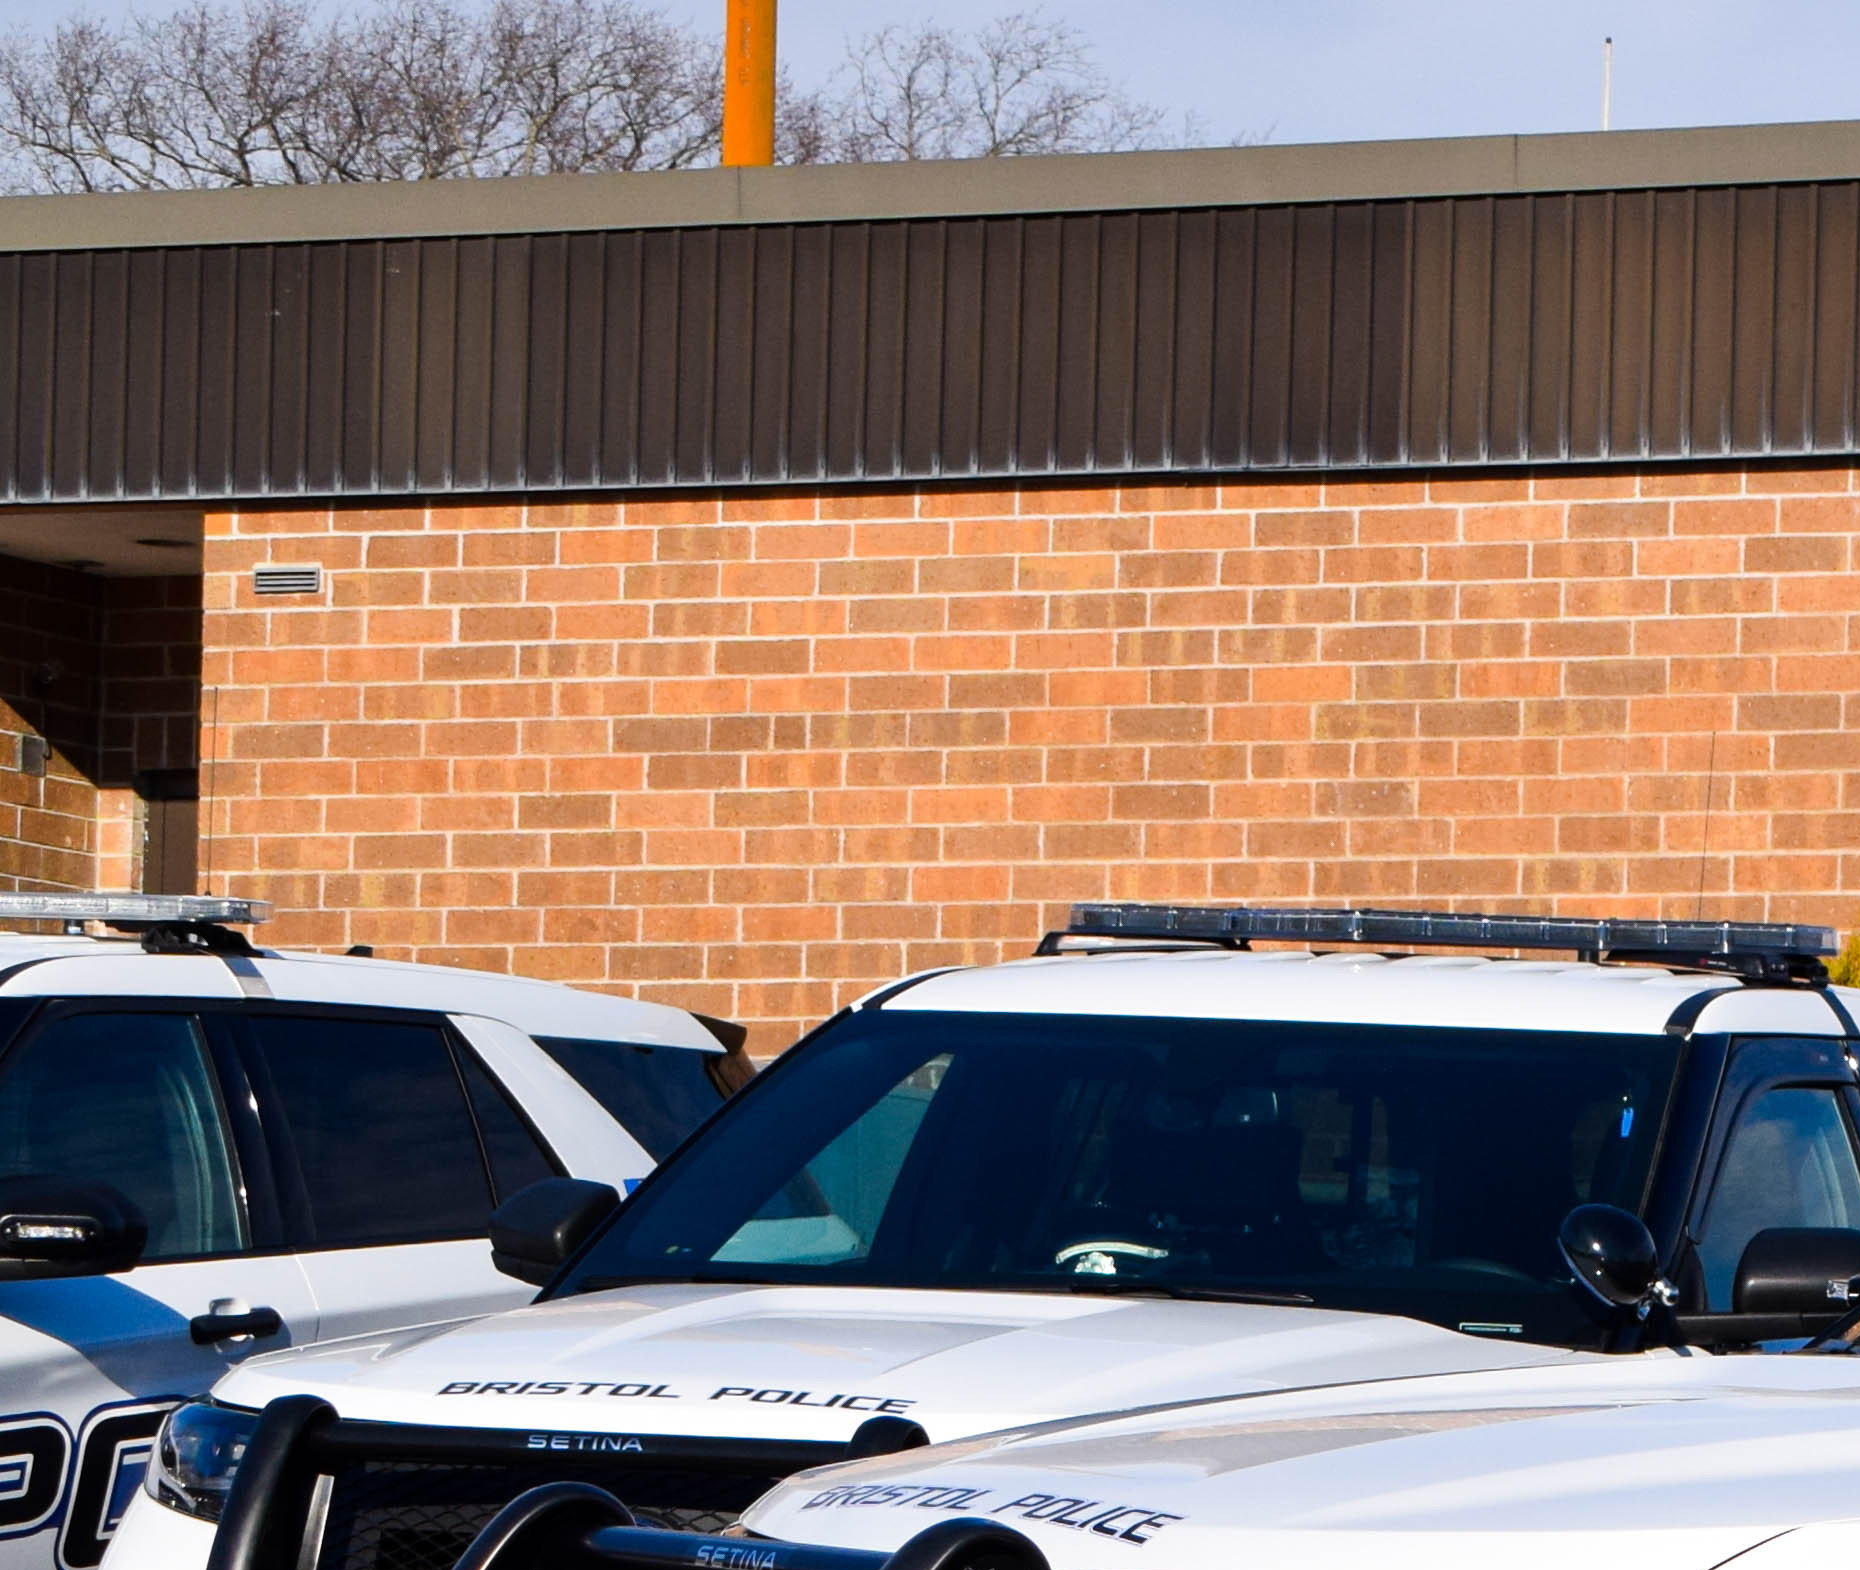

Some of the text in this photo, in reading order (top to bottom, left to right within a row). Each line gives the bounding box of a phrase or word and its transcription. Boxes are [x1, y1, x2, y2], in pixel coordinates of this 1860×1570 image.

[437, 1381, 918, 1414] BRISTOL POLICE
[527, 1434, 644, 1452] SETINA
[801, 1486, 1186, 1546] BRISTOL POLICE
[695, 1545, 776, 1570] SETINA
